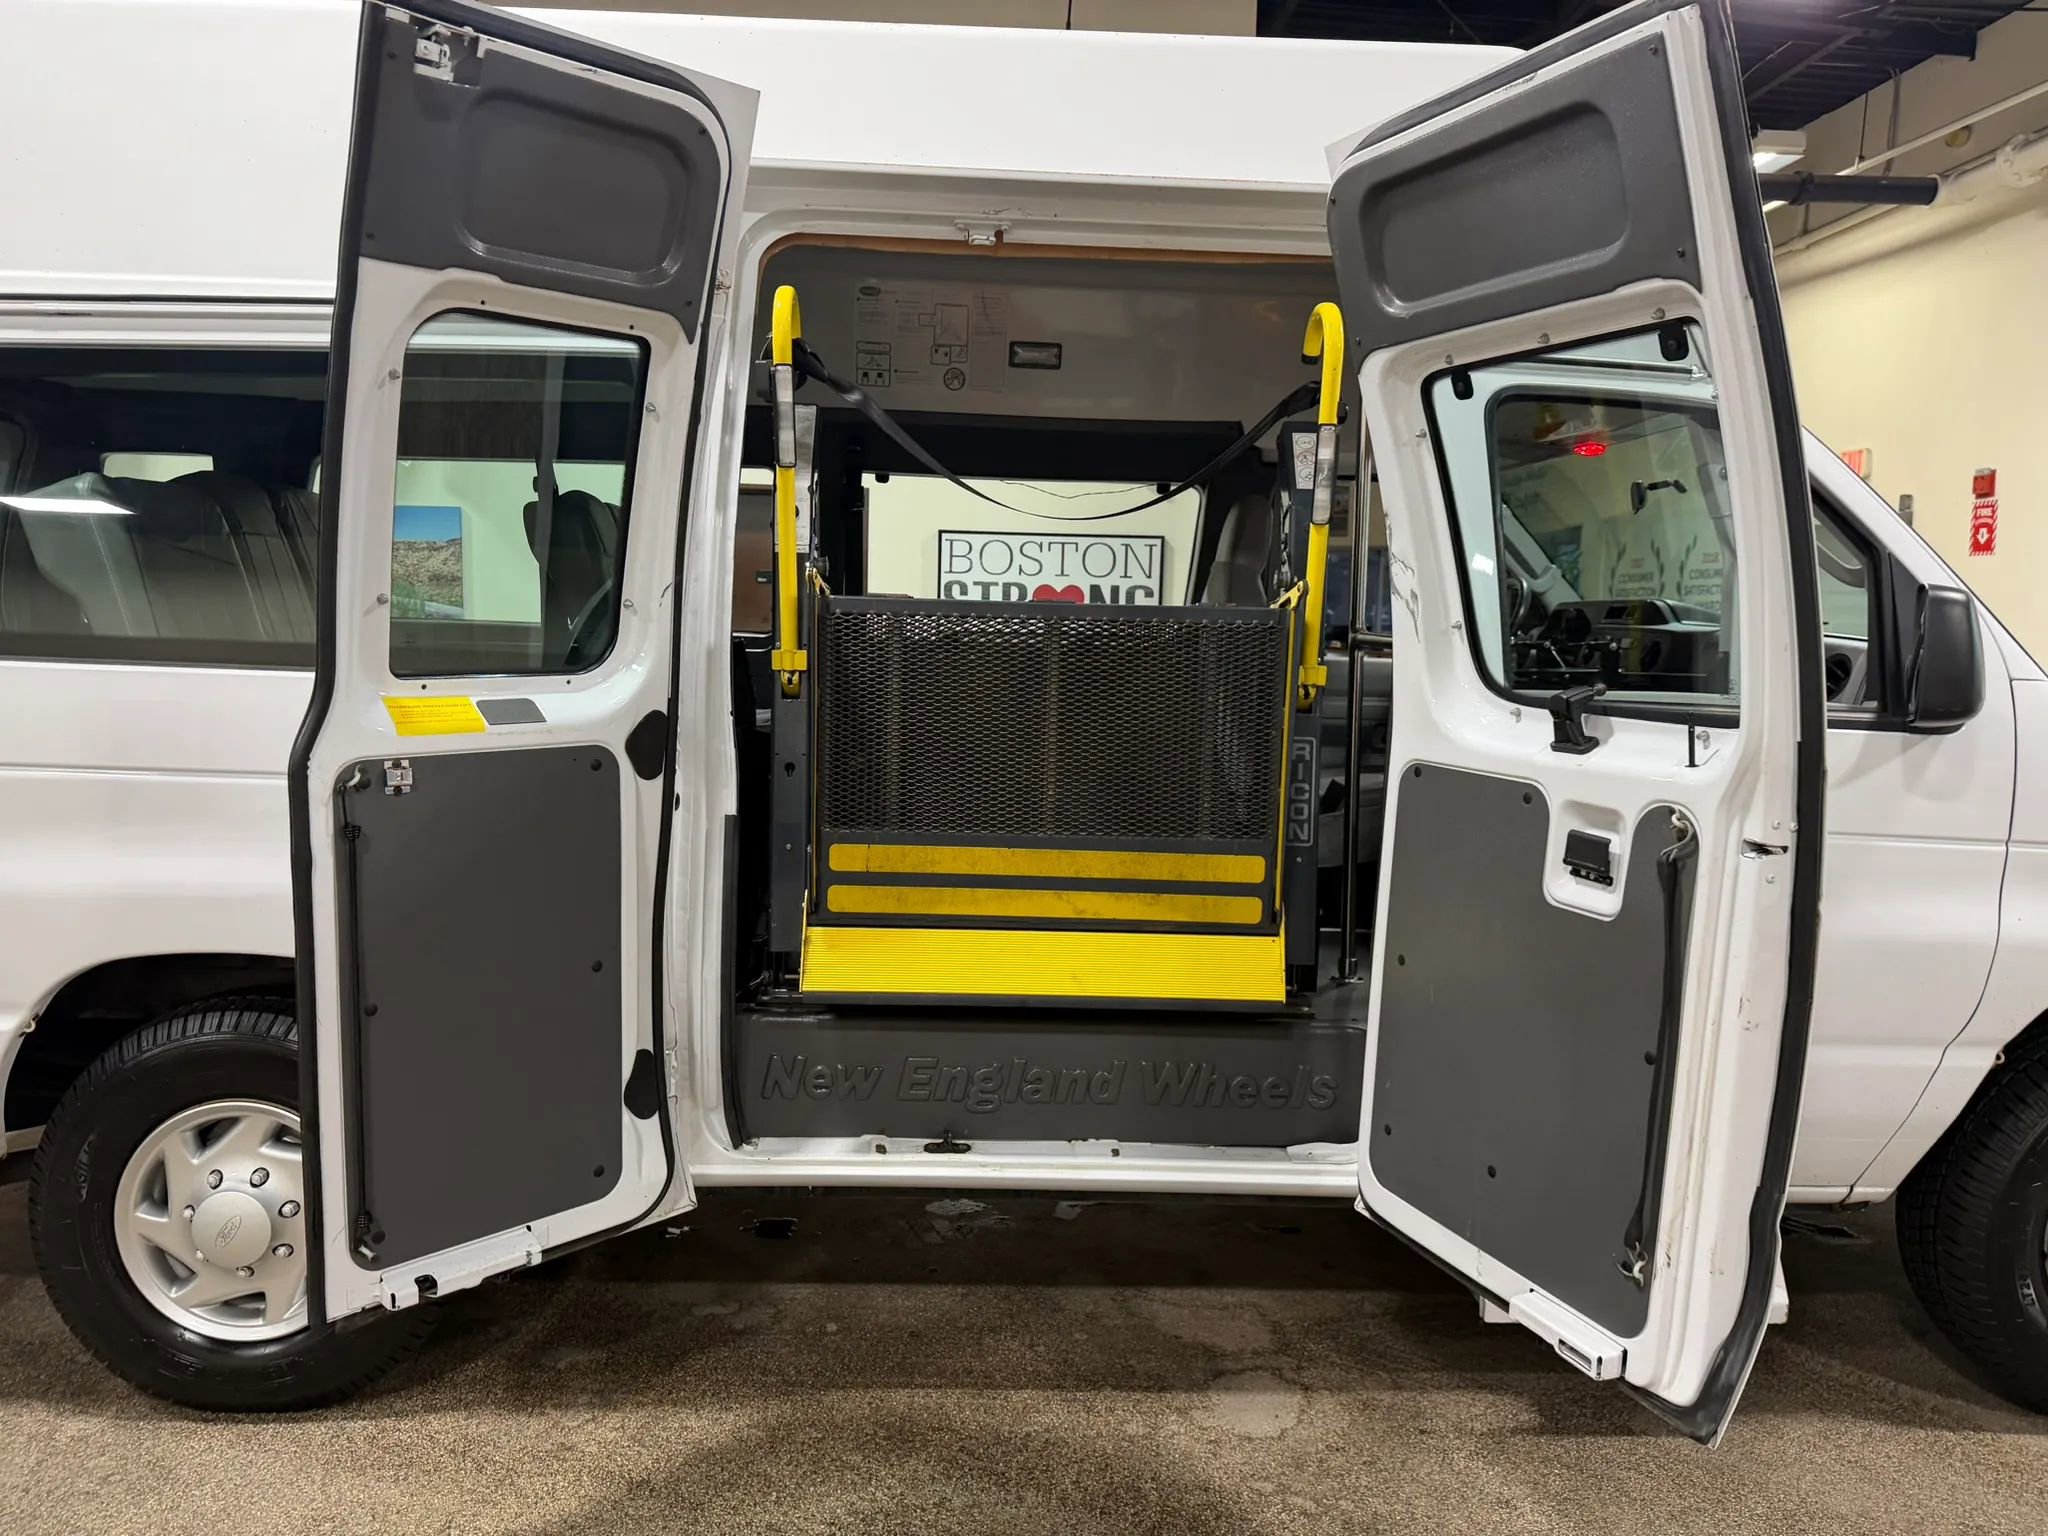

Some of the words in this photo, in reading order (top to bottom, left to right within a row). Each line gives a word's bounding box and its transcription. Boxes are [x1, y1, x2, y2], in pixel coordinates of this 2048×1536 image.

[943, 538, 1158, 579] BOSTON
[1287, 743, 1311, 841] RICON
[760, 1054, 884, 1101] New
[896, 1056, 1128, 1114] England
[1140, 1060, 1340, 1110] Wheels
